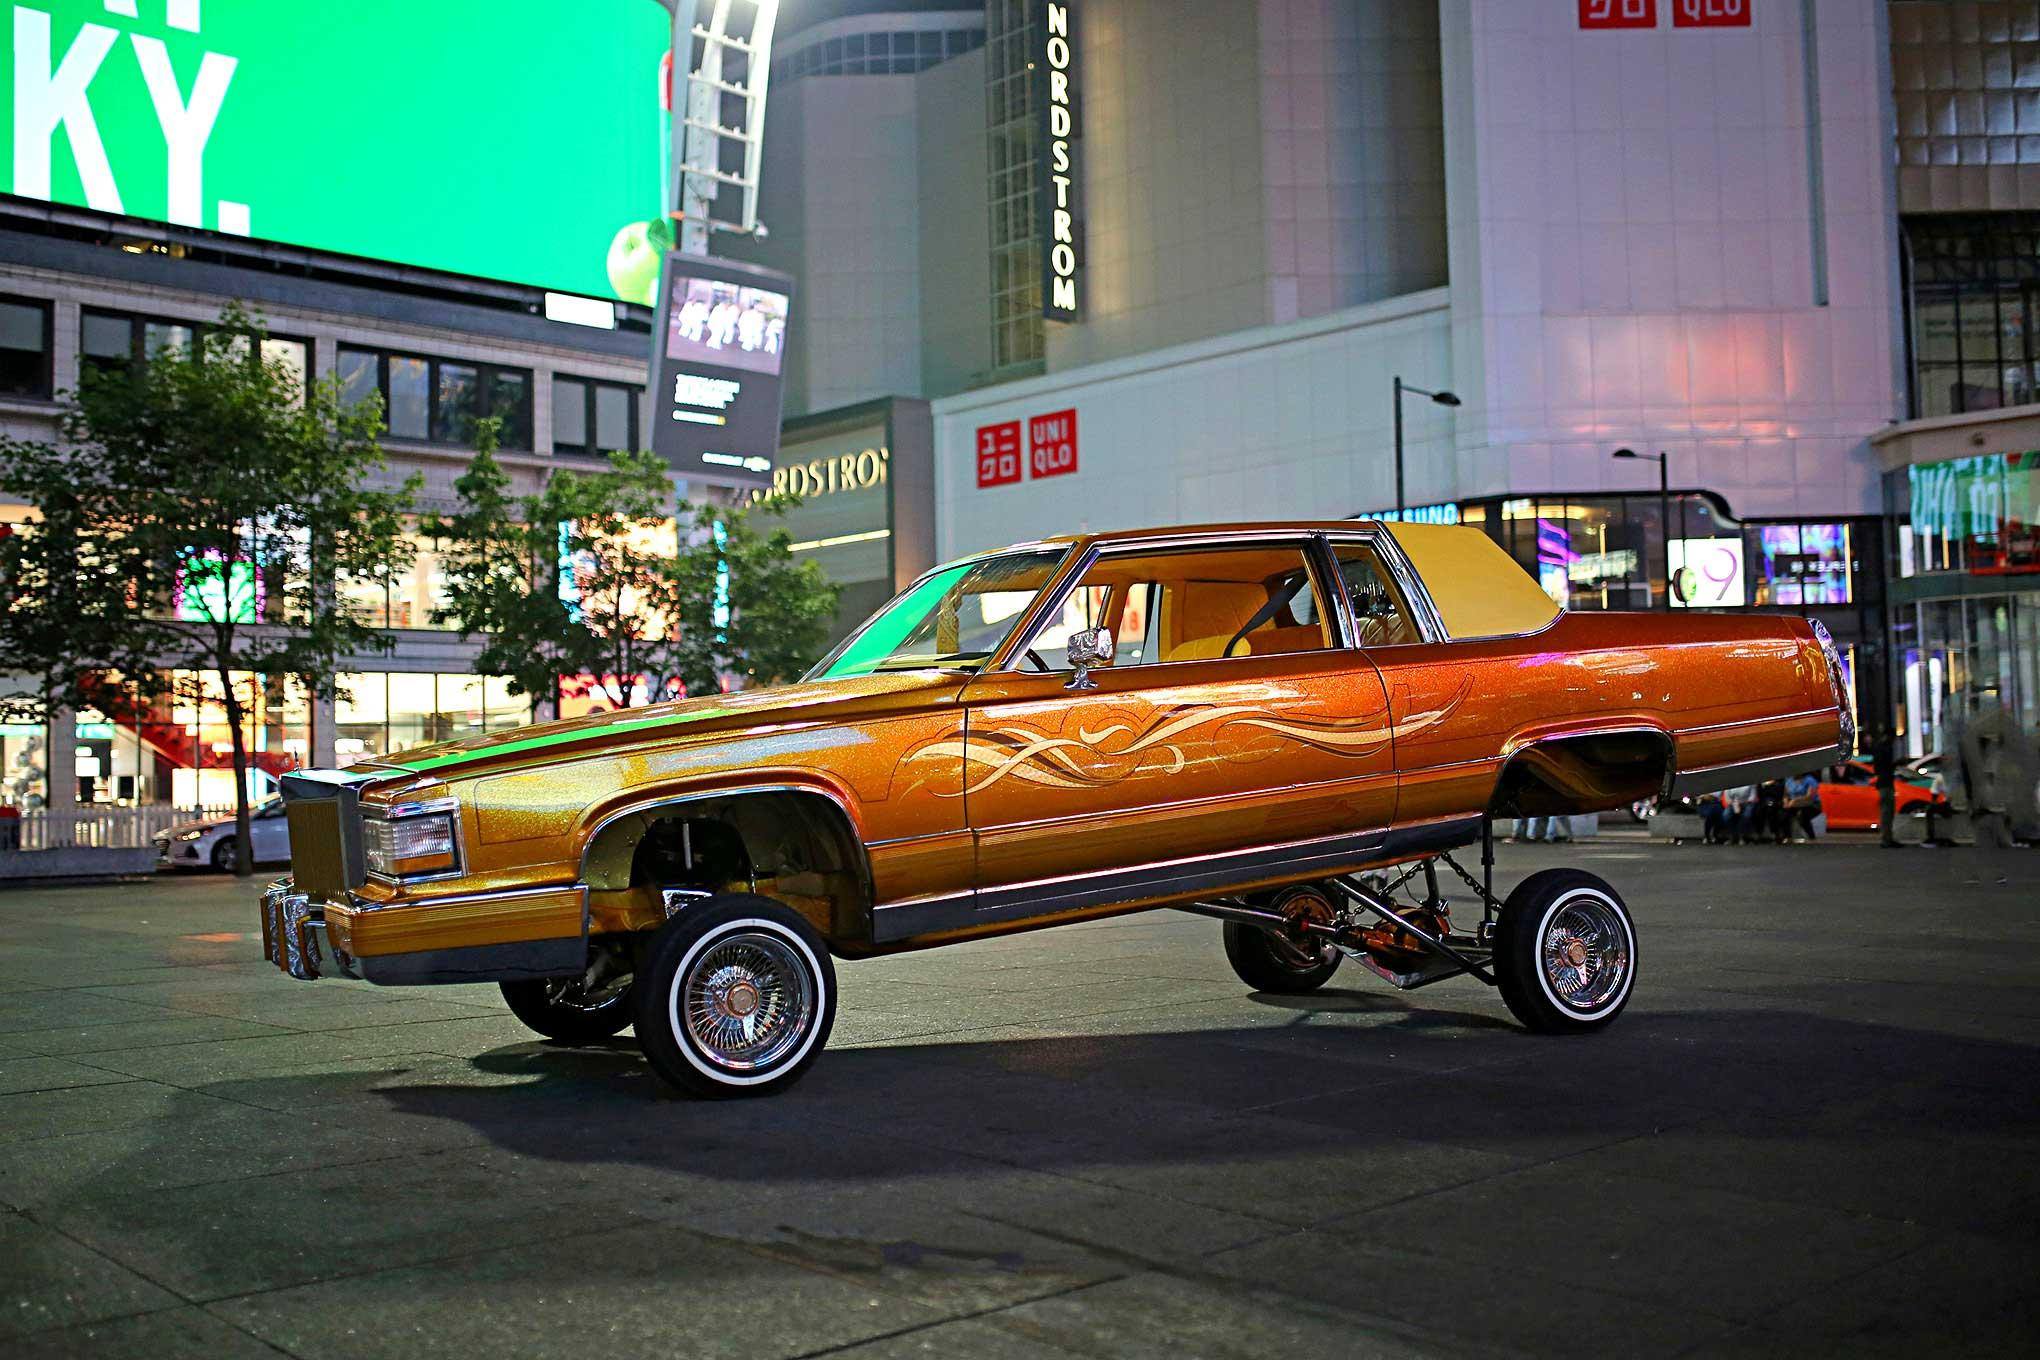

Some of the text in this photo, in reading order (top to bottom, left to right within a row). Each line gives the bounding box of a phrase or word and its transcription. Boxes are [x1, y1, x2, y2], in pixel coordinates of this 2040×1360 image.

[13, 4, 251, 238] KY.
[1046, 2, 1076, 312] NORDSTROM
[1033, 417, 1069, 446] UNI
[1034, 442, 1073, 475] QLO
[744, 447, 889, 508] RDSTRO
